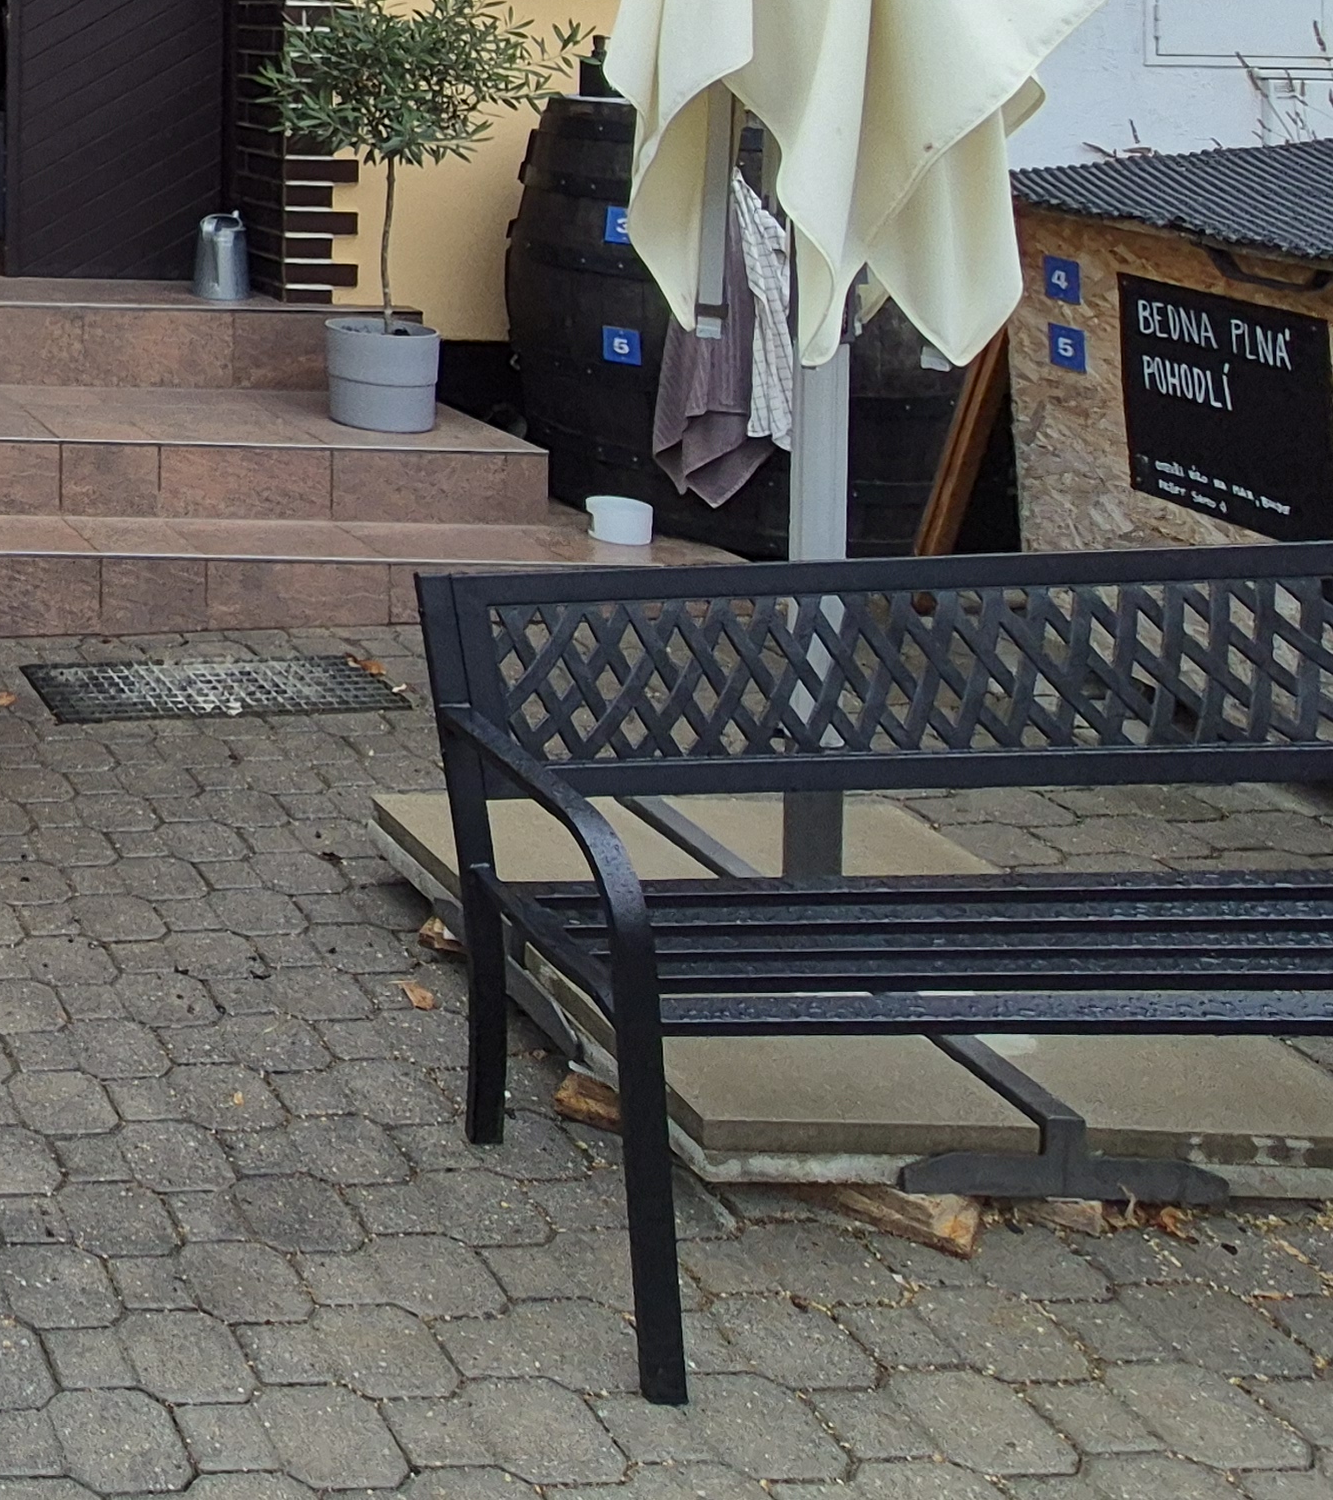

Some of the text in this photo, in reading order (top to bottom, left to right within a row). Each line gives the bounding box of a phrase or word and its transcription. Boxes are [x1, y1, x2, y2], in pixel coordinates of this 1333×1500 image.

[1051, 269, 1068, 290] 4
[1137, 299, 1292, 372] BEDNA PLNÁ
[612, 337, 629, 356] 5
[1057, 337, 1074, 357] 5
[1141, 354, 1233, 411] POHODLÍ
